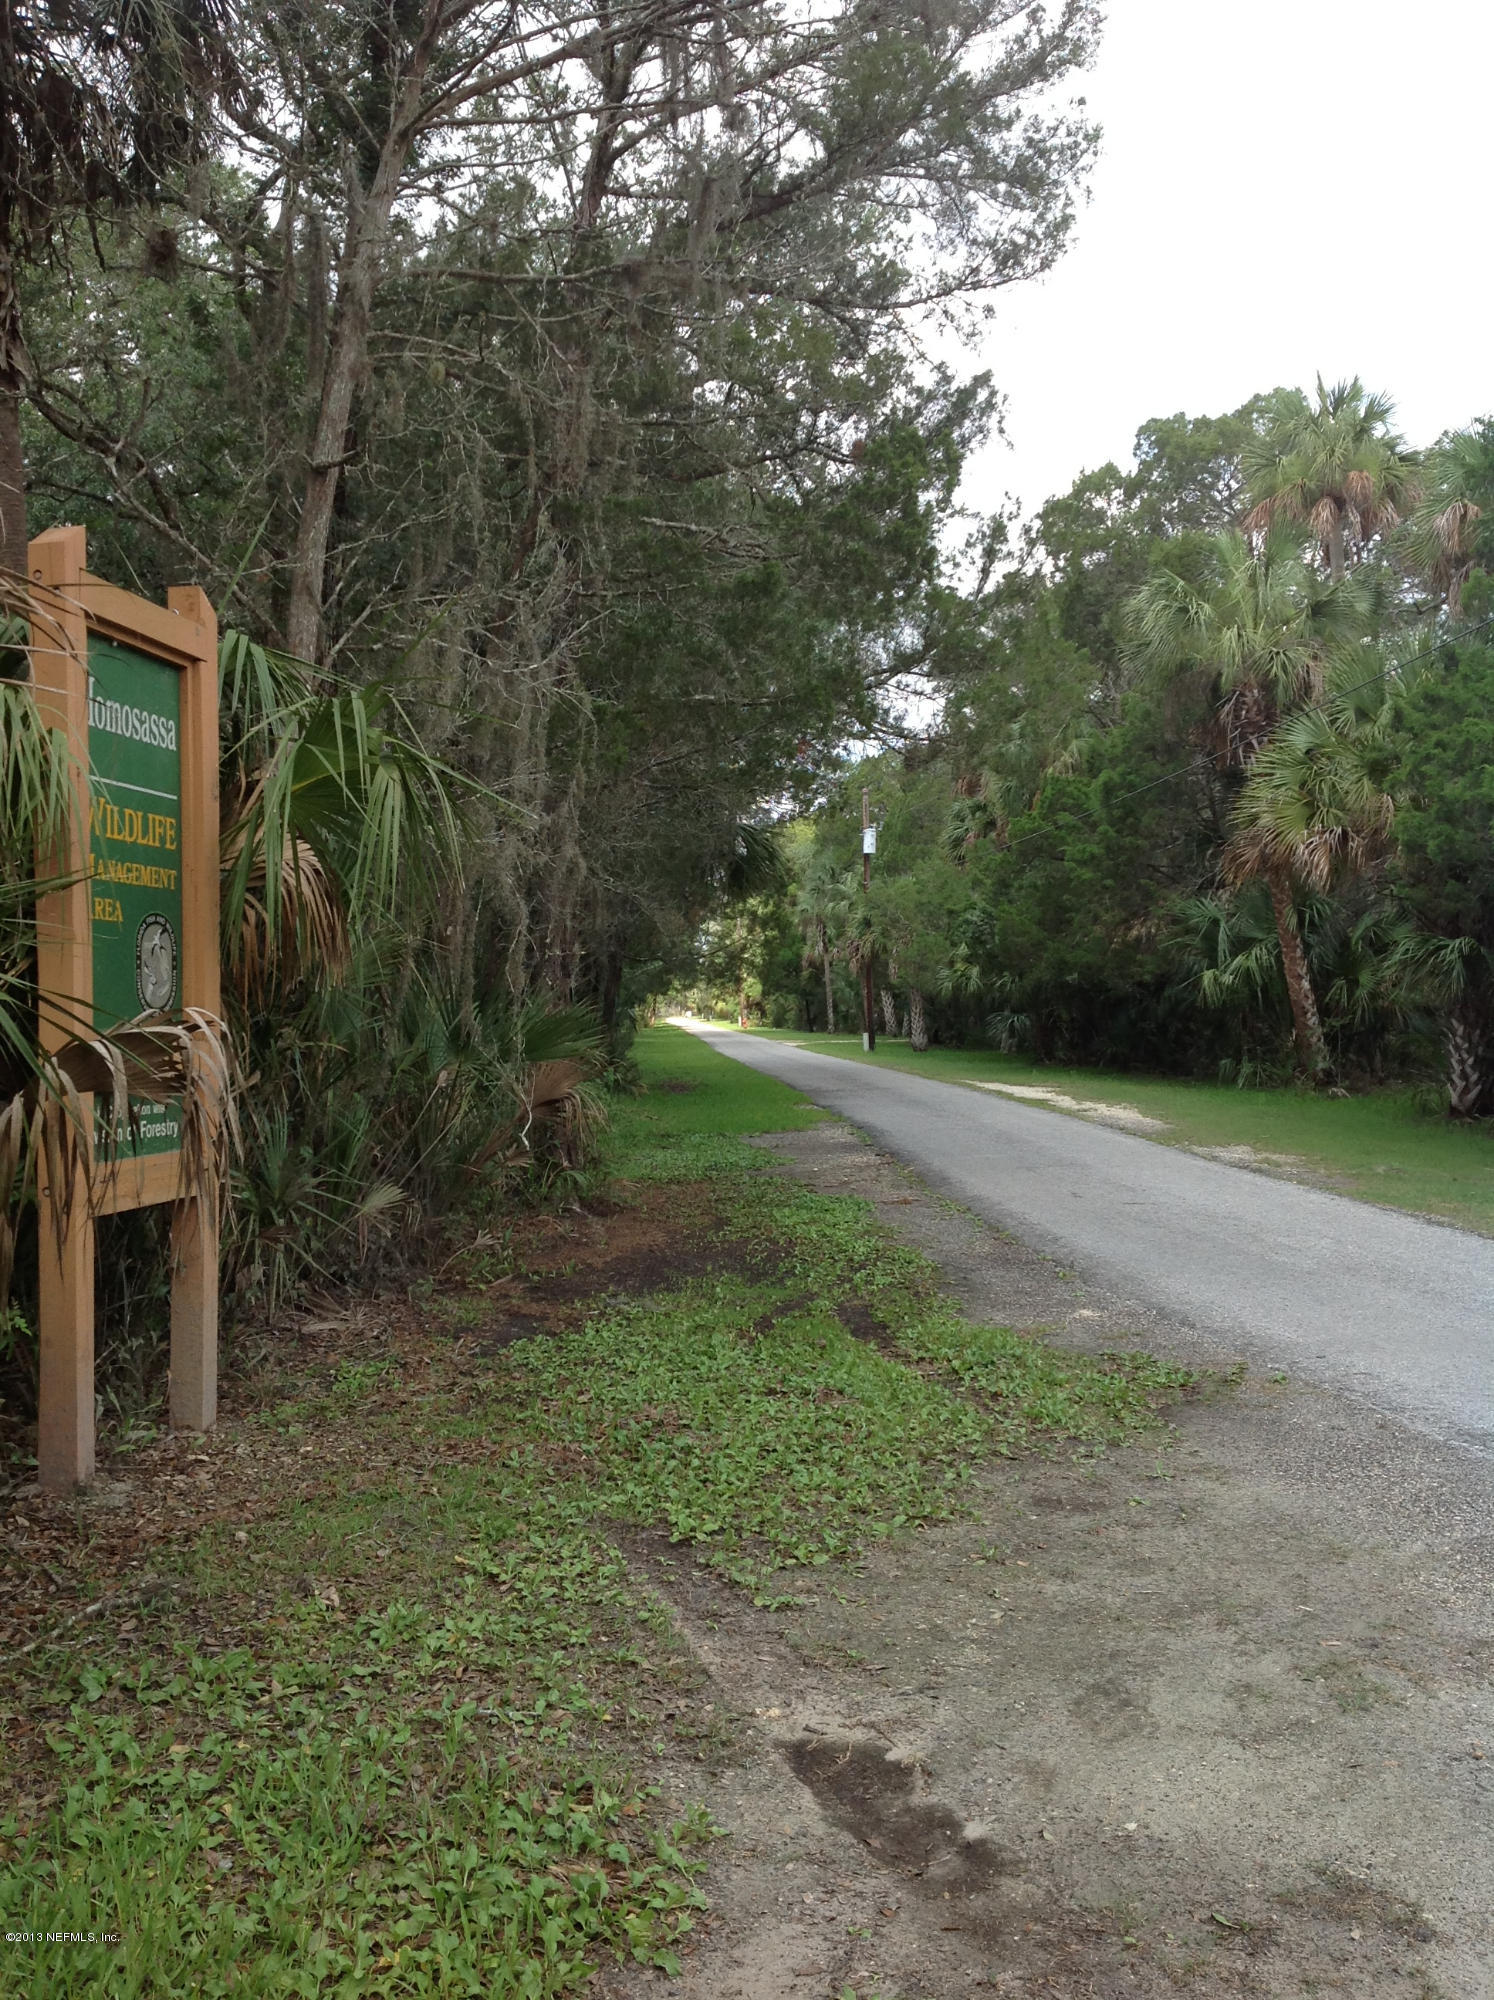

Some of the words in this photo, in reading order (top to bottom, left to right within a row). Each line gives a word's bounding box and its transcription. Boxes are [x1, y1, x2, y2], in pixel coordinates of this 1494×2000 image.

[88, 796, 177, 850] WILDLIFE
[92, 897, 123, 922] REA
[140, 1120, 179, 1138] Forestry
